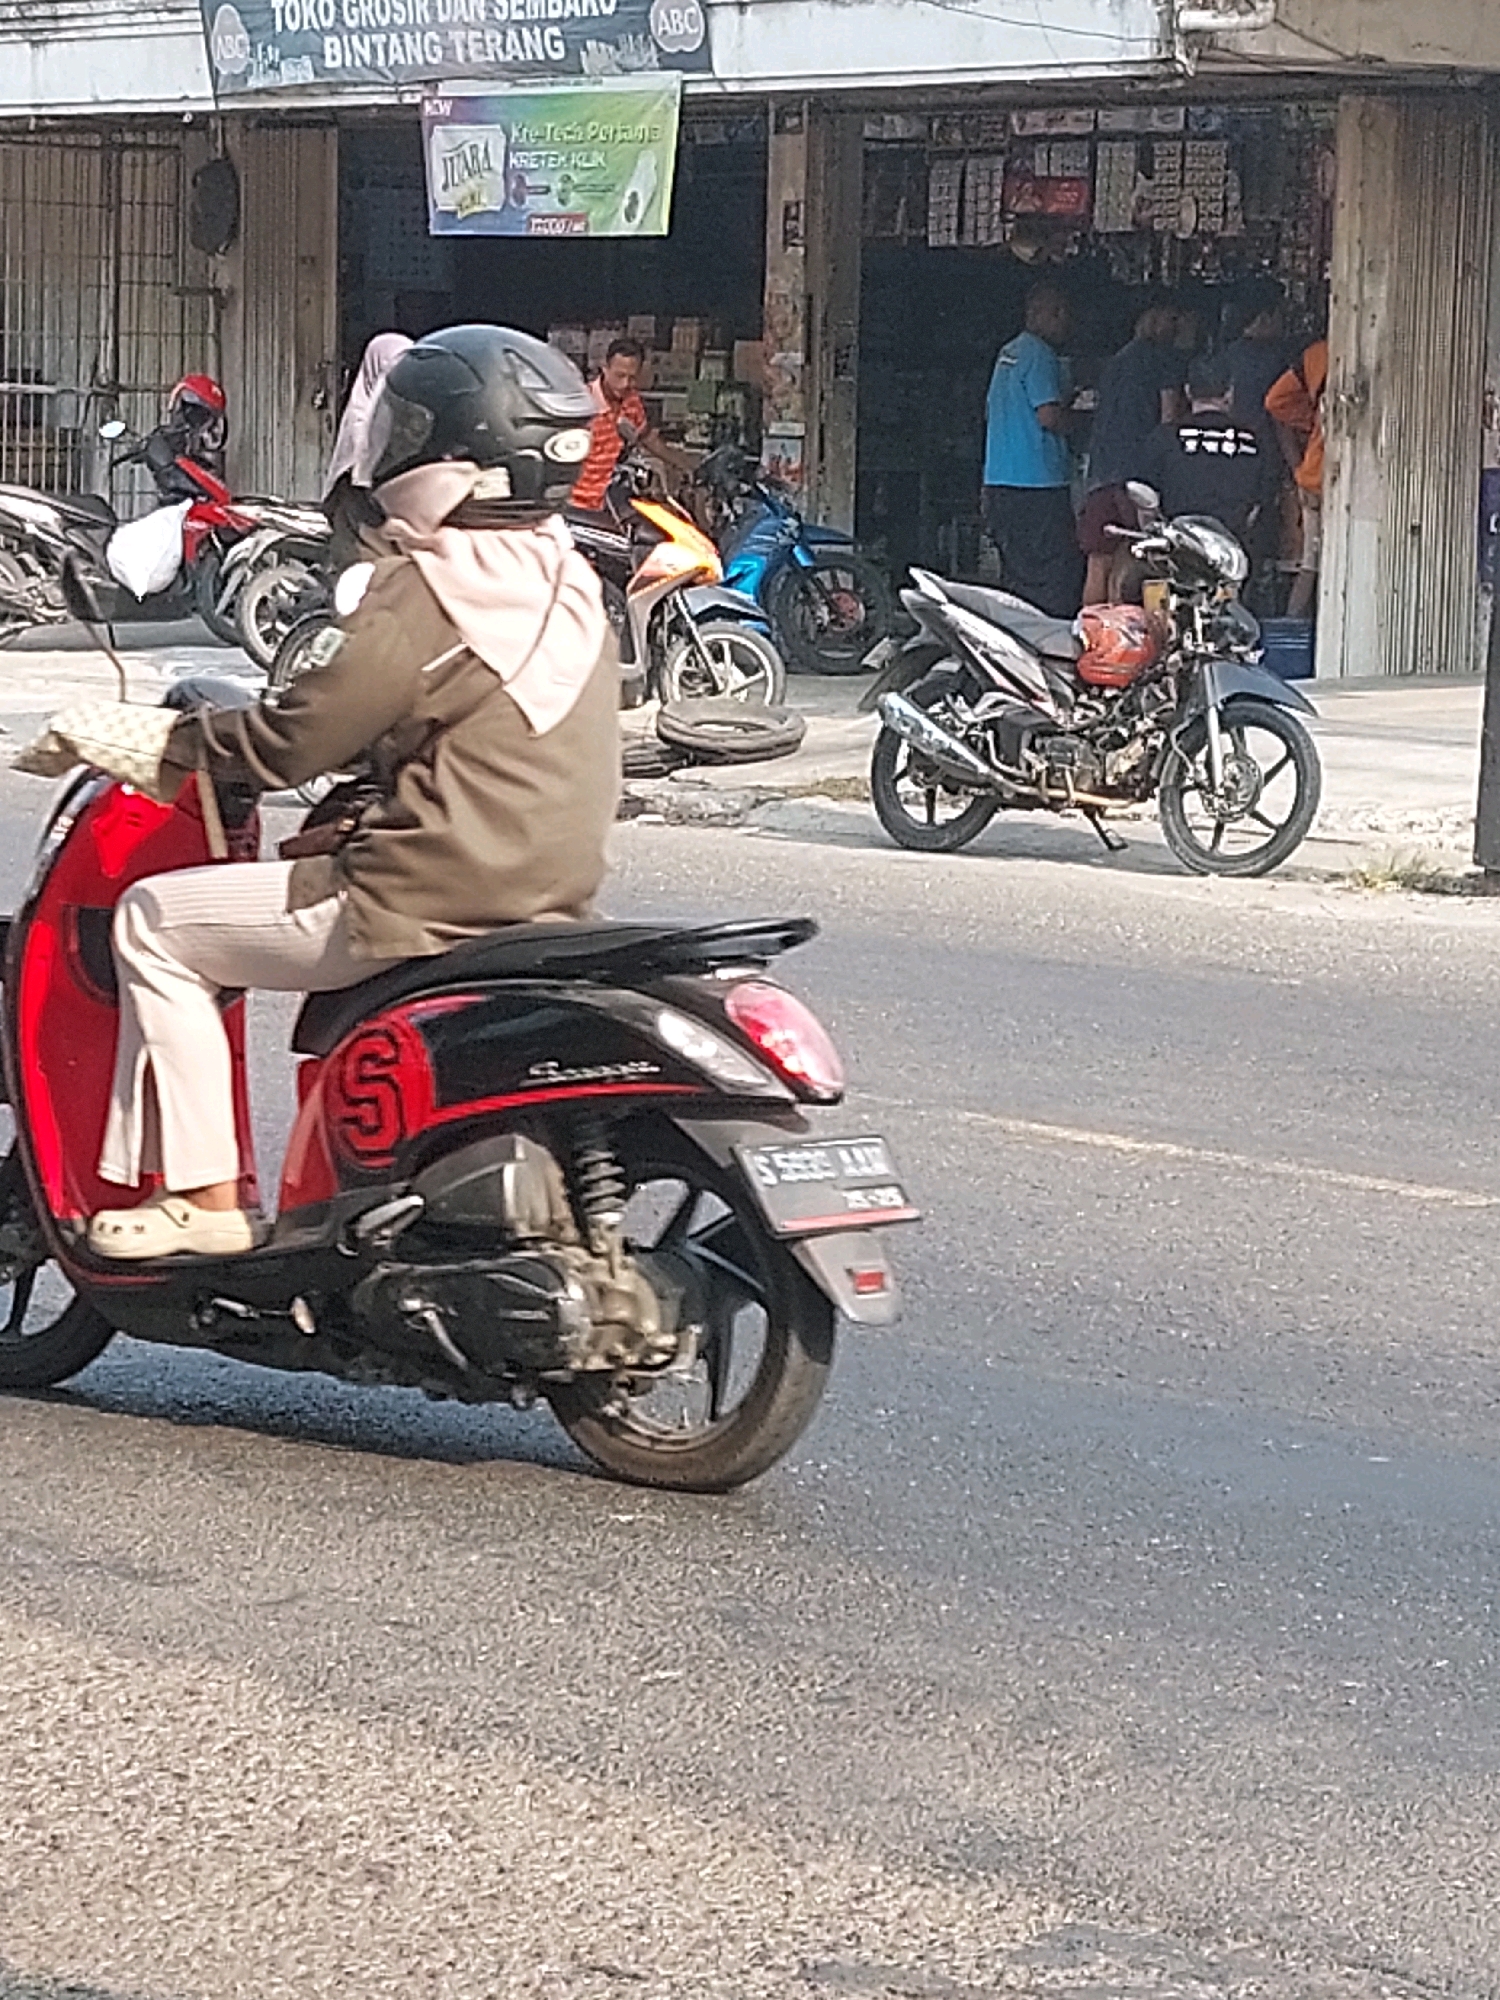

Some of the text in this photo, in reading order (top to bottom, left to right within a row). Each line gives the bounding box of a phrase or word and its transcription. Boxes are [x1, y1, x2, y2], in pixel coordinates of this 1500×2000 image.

[271, 0, 335, 32] TOKO
[342, 0, 429, 28] GROSIR
[436, 0, 484, 23] DAN
[655, 7, 699, 36] ABC
[216, 34, 247, 60] ABC
[324, 26, 565, 68] BINTANG TERANG
